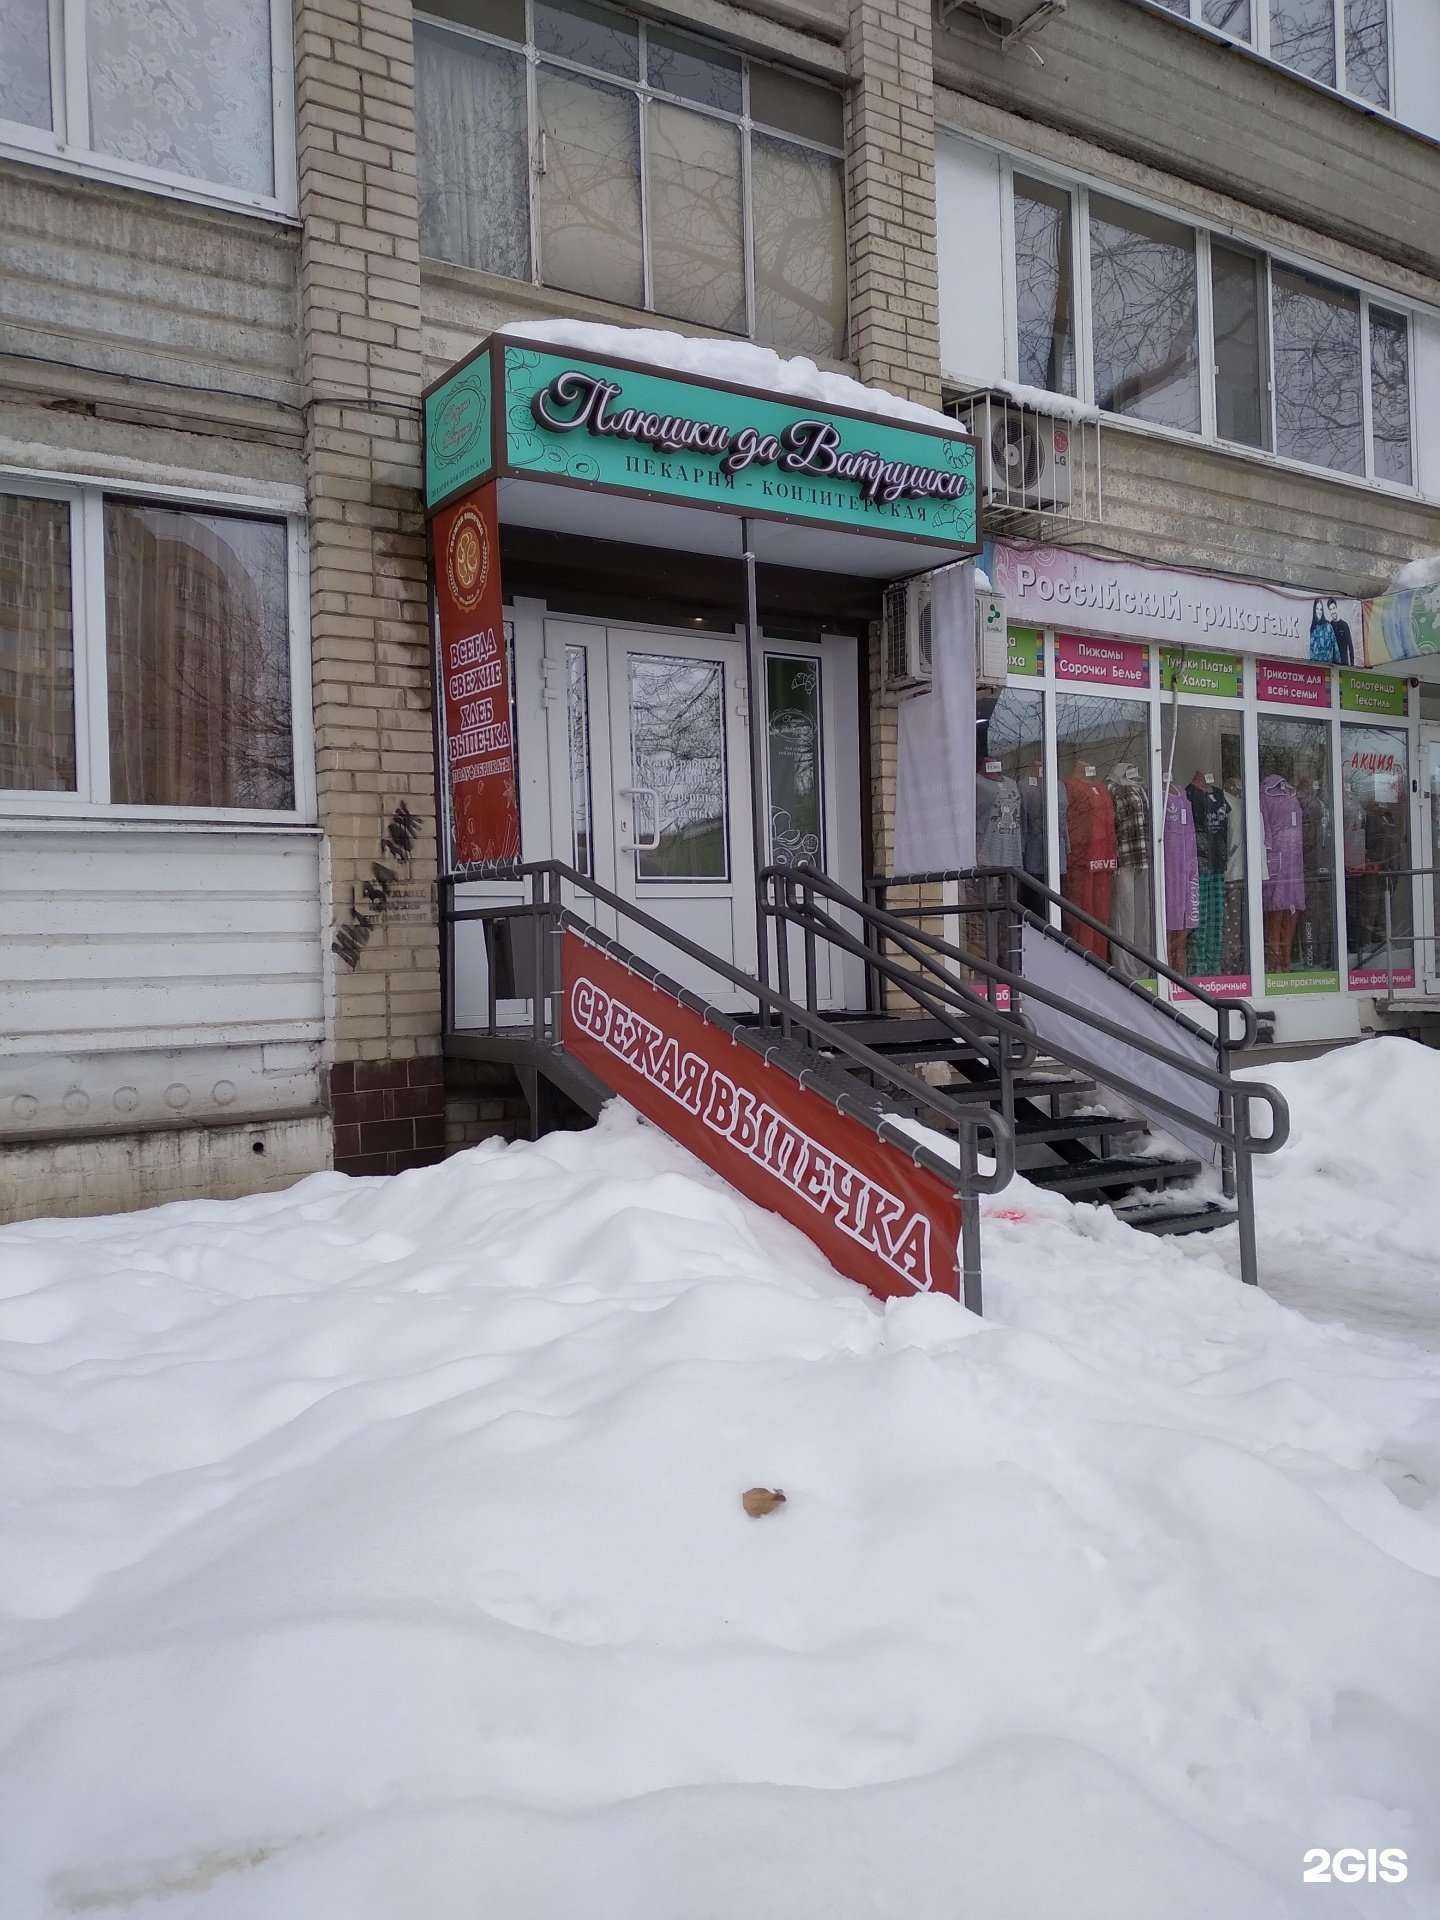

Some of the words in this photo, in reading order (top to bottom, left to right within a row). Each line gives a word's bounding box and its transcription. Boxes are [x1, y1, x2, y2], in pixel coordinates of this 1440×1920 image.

[535, 370, 730, 453] Плюшки
[726, 427, 782, 471] да
[784, 420, 966, 500] Ватрушки
[1055, 455, 1067, 466] LG
[624, 455, 736, 490] ПЕКАРНЯ
[1017, 563, 1182, 622] Российский
[1187, 603, 1301, 640] трикотаж
[450, 628, 496, 669] ВСЕГДА
[1078, 643, 1124, 661] Пижамы
[1059, 659, 1107, 677] Сорочки
[1112, 665, 1142, 680] Белье
[1200, 658, 1233, 674] Платья
[1262, 666, 1305, 684] Трикотаж
[1307, 674, 1322, 685] для
[450, 660, 502, 700] СВЕЖИЕ
[1182, 674, 1220, 689] Халаты
[1350, 678, 1395, 694] Полотенца
[1267, 685, 1289, 697] всей
[1291, 689, 1318, 700] семьи
[460, 697, 493, 731] ХЛЕБ
[449, 721, 511, 761] ВЫПЕЧКА
[1351, 751, 1394, 773] АКЦИЯ
[571, 976, 708, 1114] СВЕЖАЯ
[703, 1070, 932, 1292] ВЫПЕЧКА
